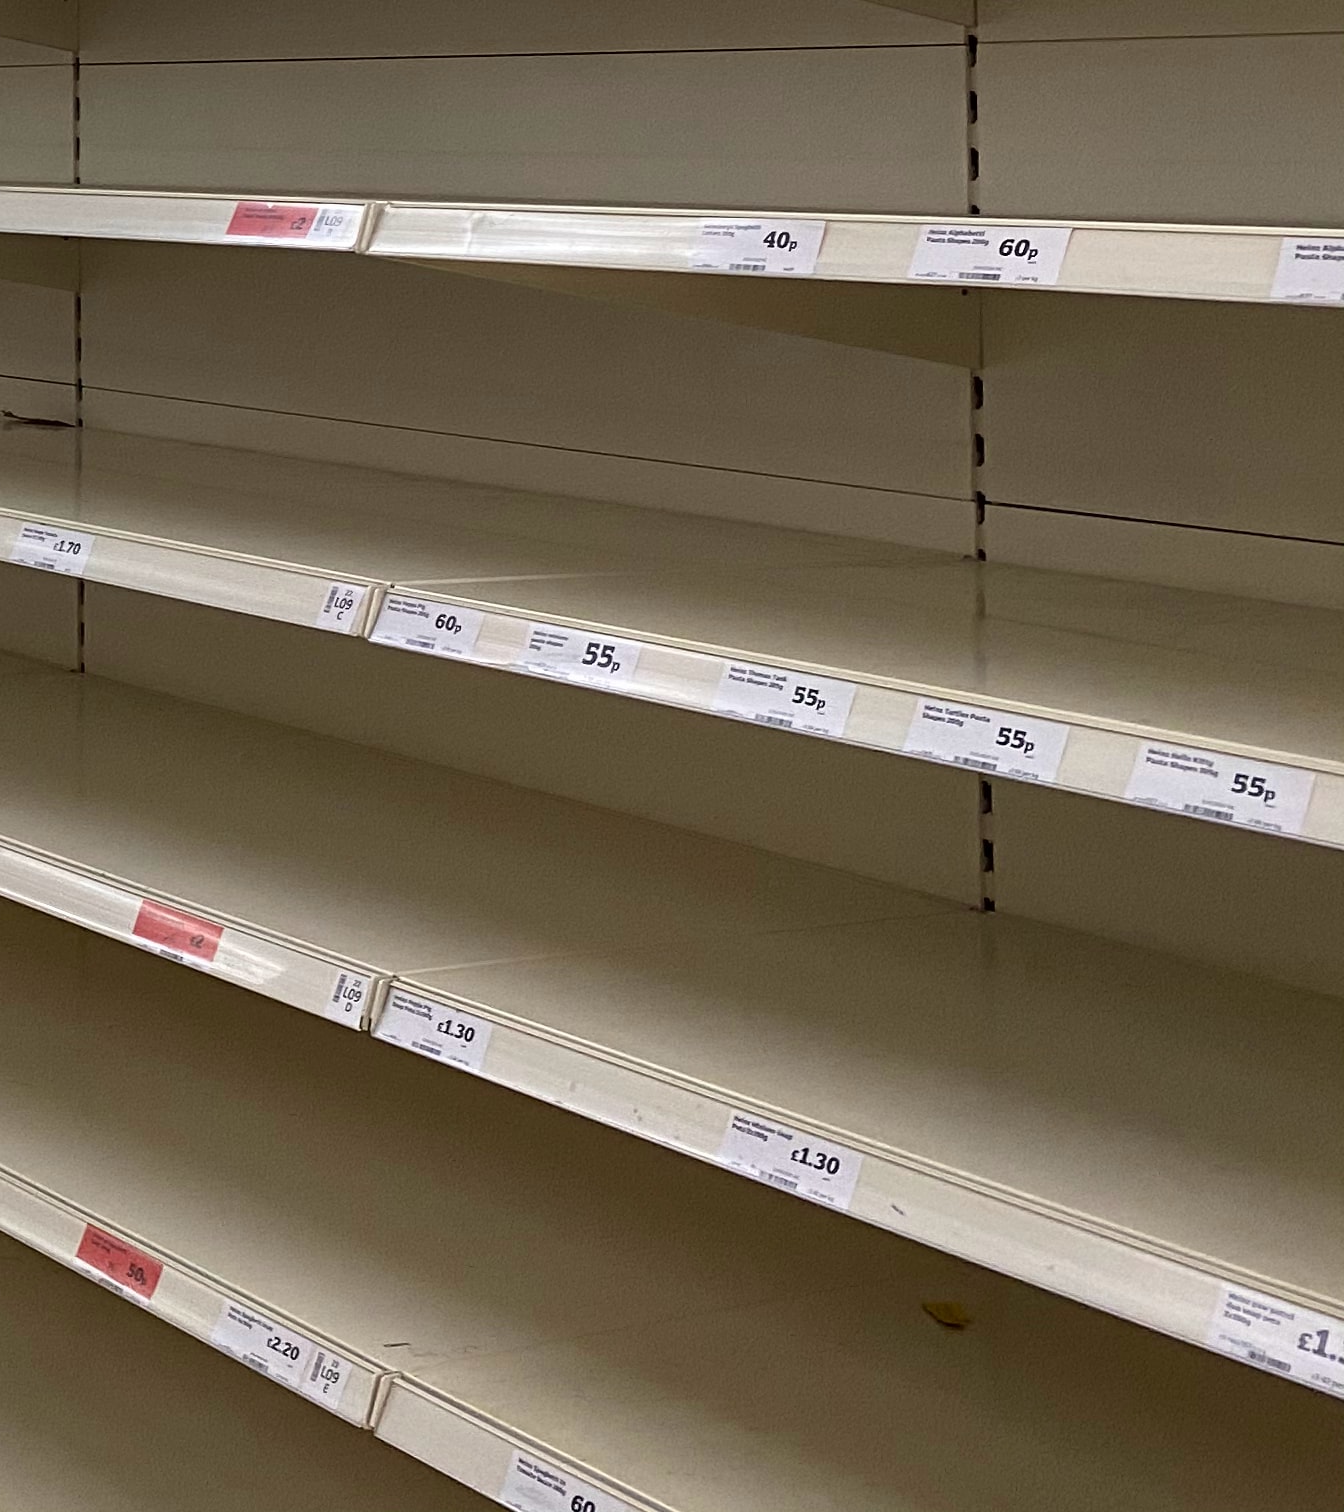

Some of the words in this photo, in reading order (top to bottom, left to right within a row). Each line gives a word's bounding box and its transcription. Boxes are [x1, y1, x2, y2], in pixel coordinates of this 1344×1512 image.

[763, 231, 799, 252] 40p
[998, 239, 1039, 262] 60p
[53, 539, 81, 555] £1.70
[334, 596, 354, 610] L09
[336, 611, 344, 621] C
[434, 613, 463, 635] 60p
[581, 641, 621, 674] 55p
[791, 686, 826, 710] 55p
[995, 727, 1034, 754] 55p
[1230, 773, 1276, 803] 55p
[342, 988, 363, 1003] L09
[344, 1002, 352, 1012] D
[436, 1019, 476, 1043] £1.30
[790, 1146, 840, 1175] £1.30
[126, 1263, 148, 1287] 50p
[267, 1335, 300, 1361] £2.20
[1296, 1328, 1344, 1368] £1.
[320, 1364, 340, 1384] L09
[322, 1383, 330, 1394] E
